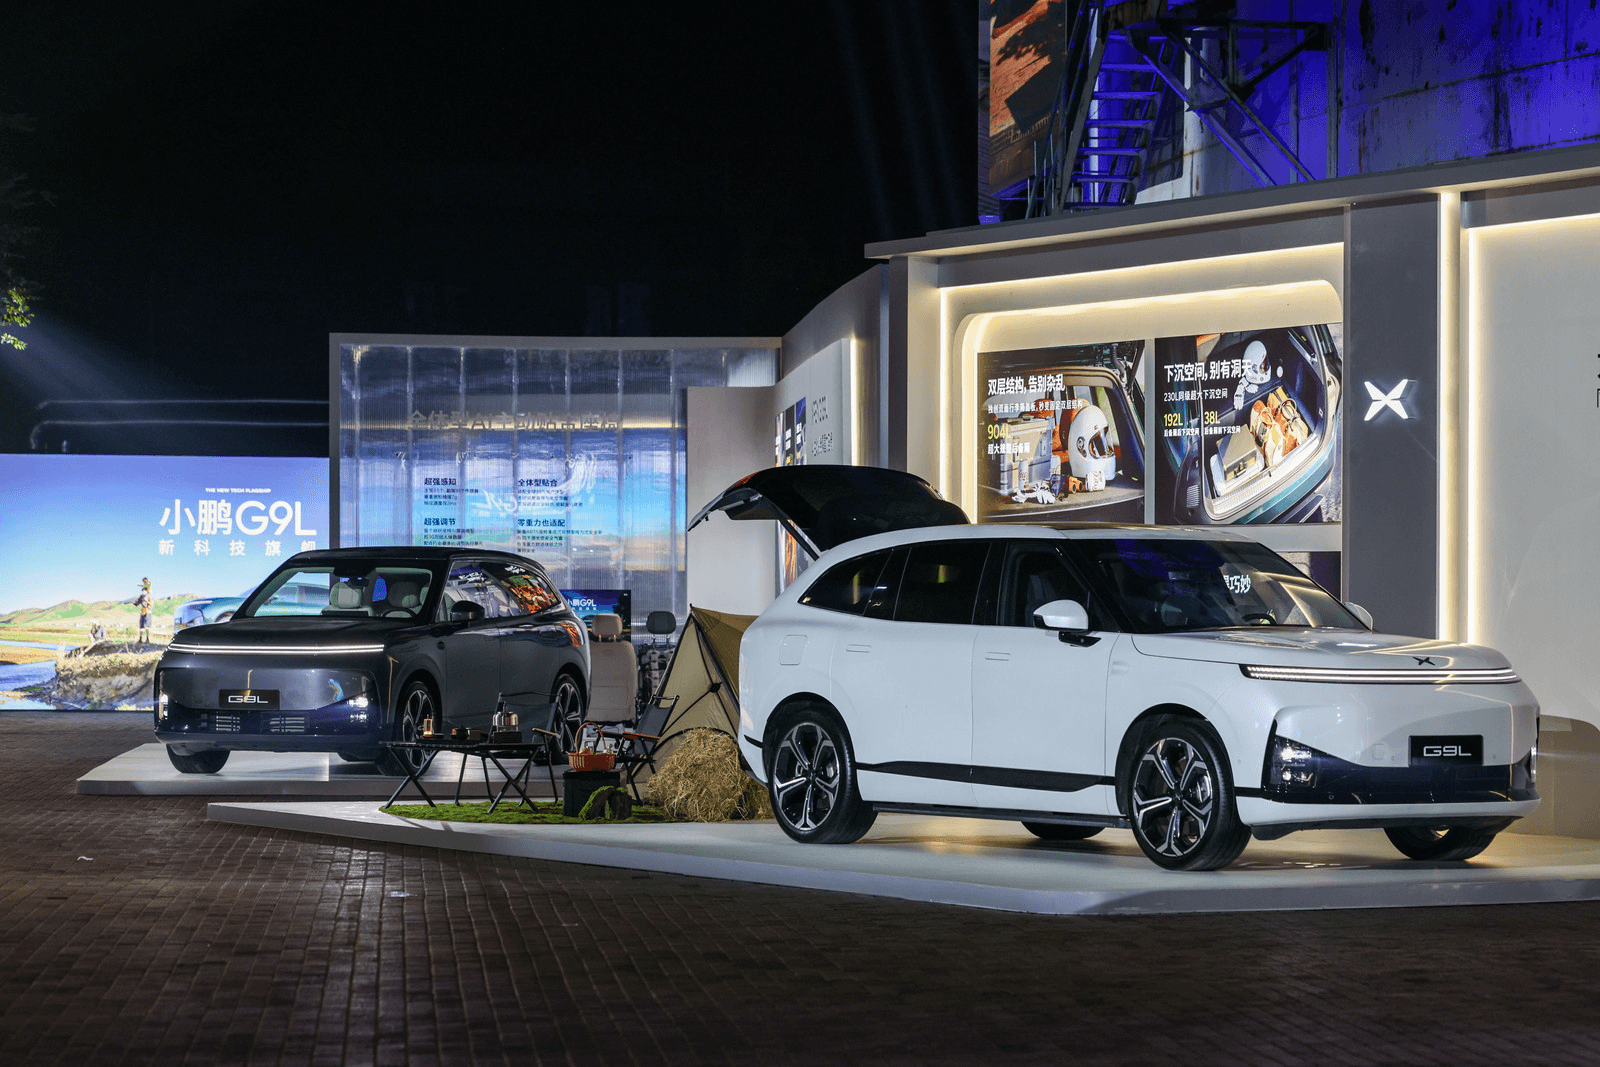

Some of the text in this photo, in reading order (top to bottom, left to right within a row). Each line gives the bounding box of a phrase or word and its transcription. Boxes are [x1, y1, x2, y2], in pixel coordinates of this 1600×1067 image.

[1163, 413, 1184, 427] 192L
[1204, 410, 1221, 425] 38L
[987, 423, 1012, 440] 904L
[517, 478, 558, 487] 全体型贴合
[159, 499, 317, 536] 小鹏G9L
[517, 518, 566, 527] 零重力也适配
[228, 695, 269, 704] G9L
[1423, 745, 1472, 757] G9L
